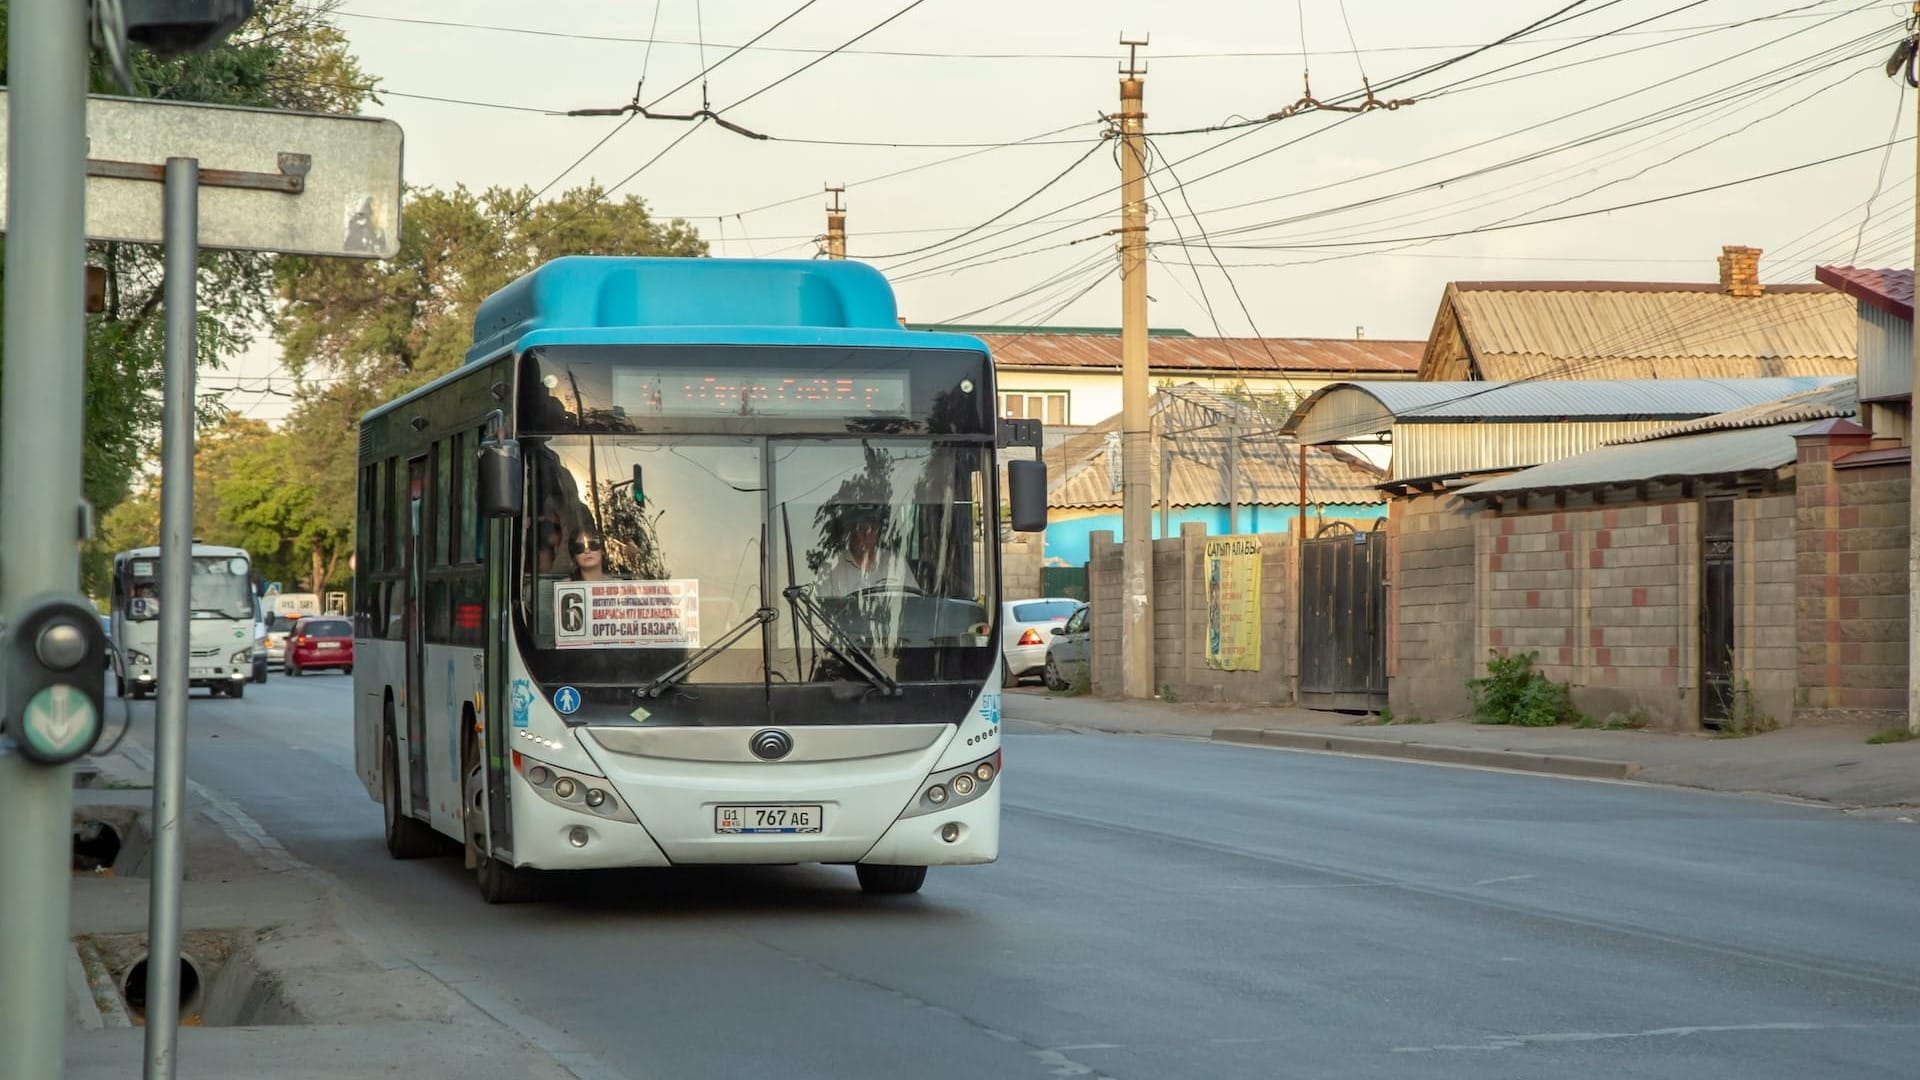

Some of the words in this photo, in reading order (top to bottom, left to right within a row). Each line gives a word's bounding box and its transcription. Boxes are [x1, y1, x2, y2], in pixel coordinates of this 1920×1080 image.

[1207, 542, 1231, 557] САТЫП
[561, 593, 583, 632] 6
[593, 621, 639, 637] ОРТО-САЙ
[724, 809, 738, 821] 01
[756, 810, 786, 826] 767
[791, 812, 809, 826] AG
